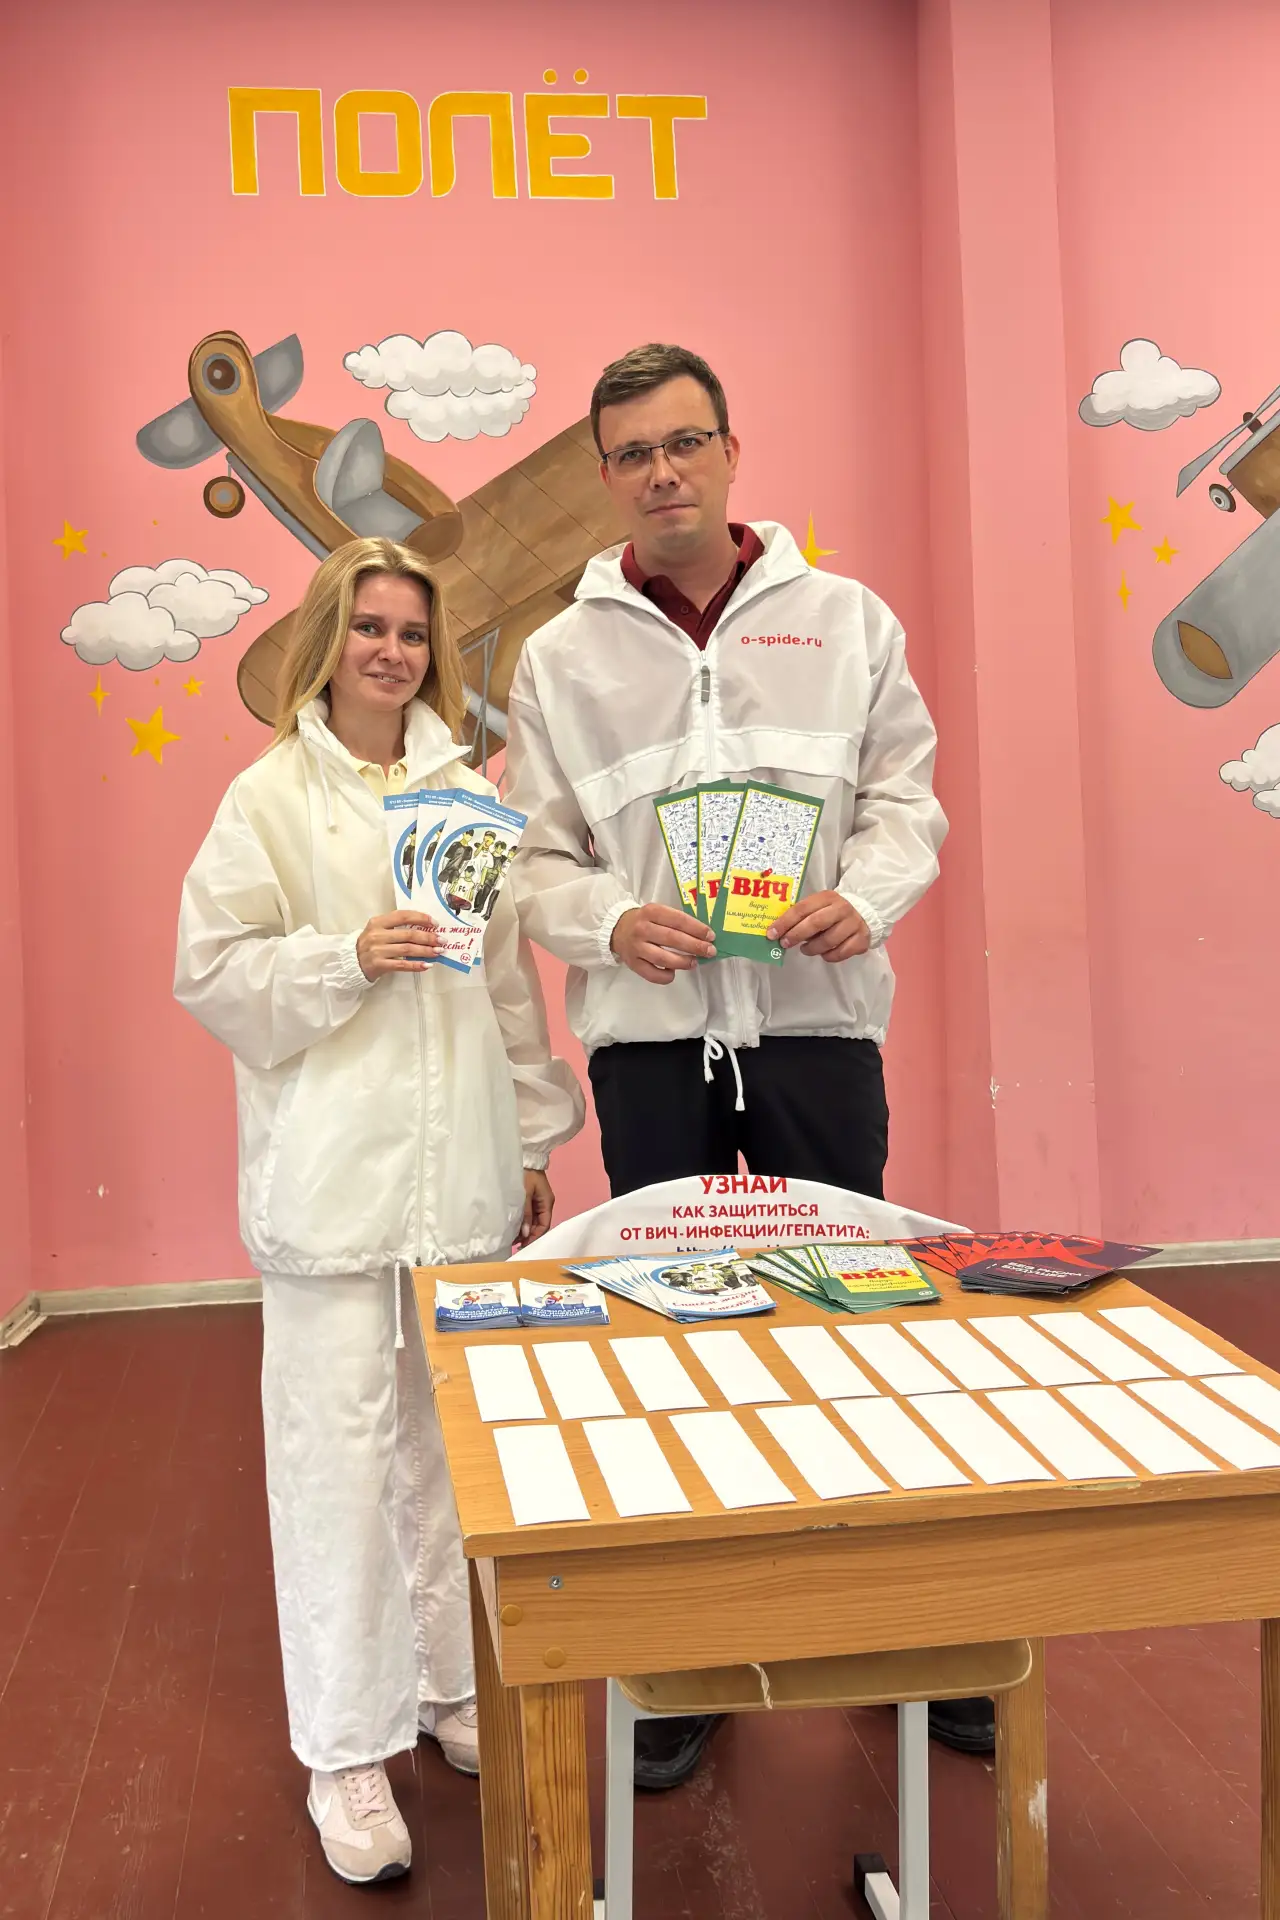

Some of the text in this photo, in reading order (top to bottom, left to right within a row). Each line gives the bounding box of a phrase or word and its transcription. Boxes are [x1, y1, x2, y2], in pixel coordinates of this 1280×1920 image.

[228, 68, 707, 199] ПОЛЁТ
[741, 633, 822, 648] o-spide.ru
[731, 876, 789, 902] ВИЧ
[449, 926, 482, 936] жизнь
[673, 1203, 818, 1219] КАК ЗАЩИТИТЬСЯ
[620, 1227, 641, 1240] ОТ
